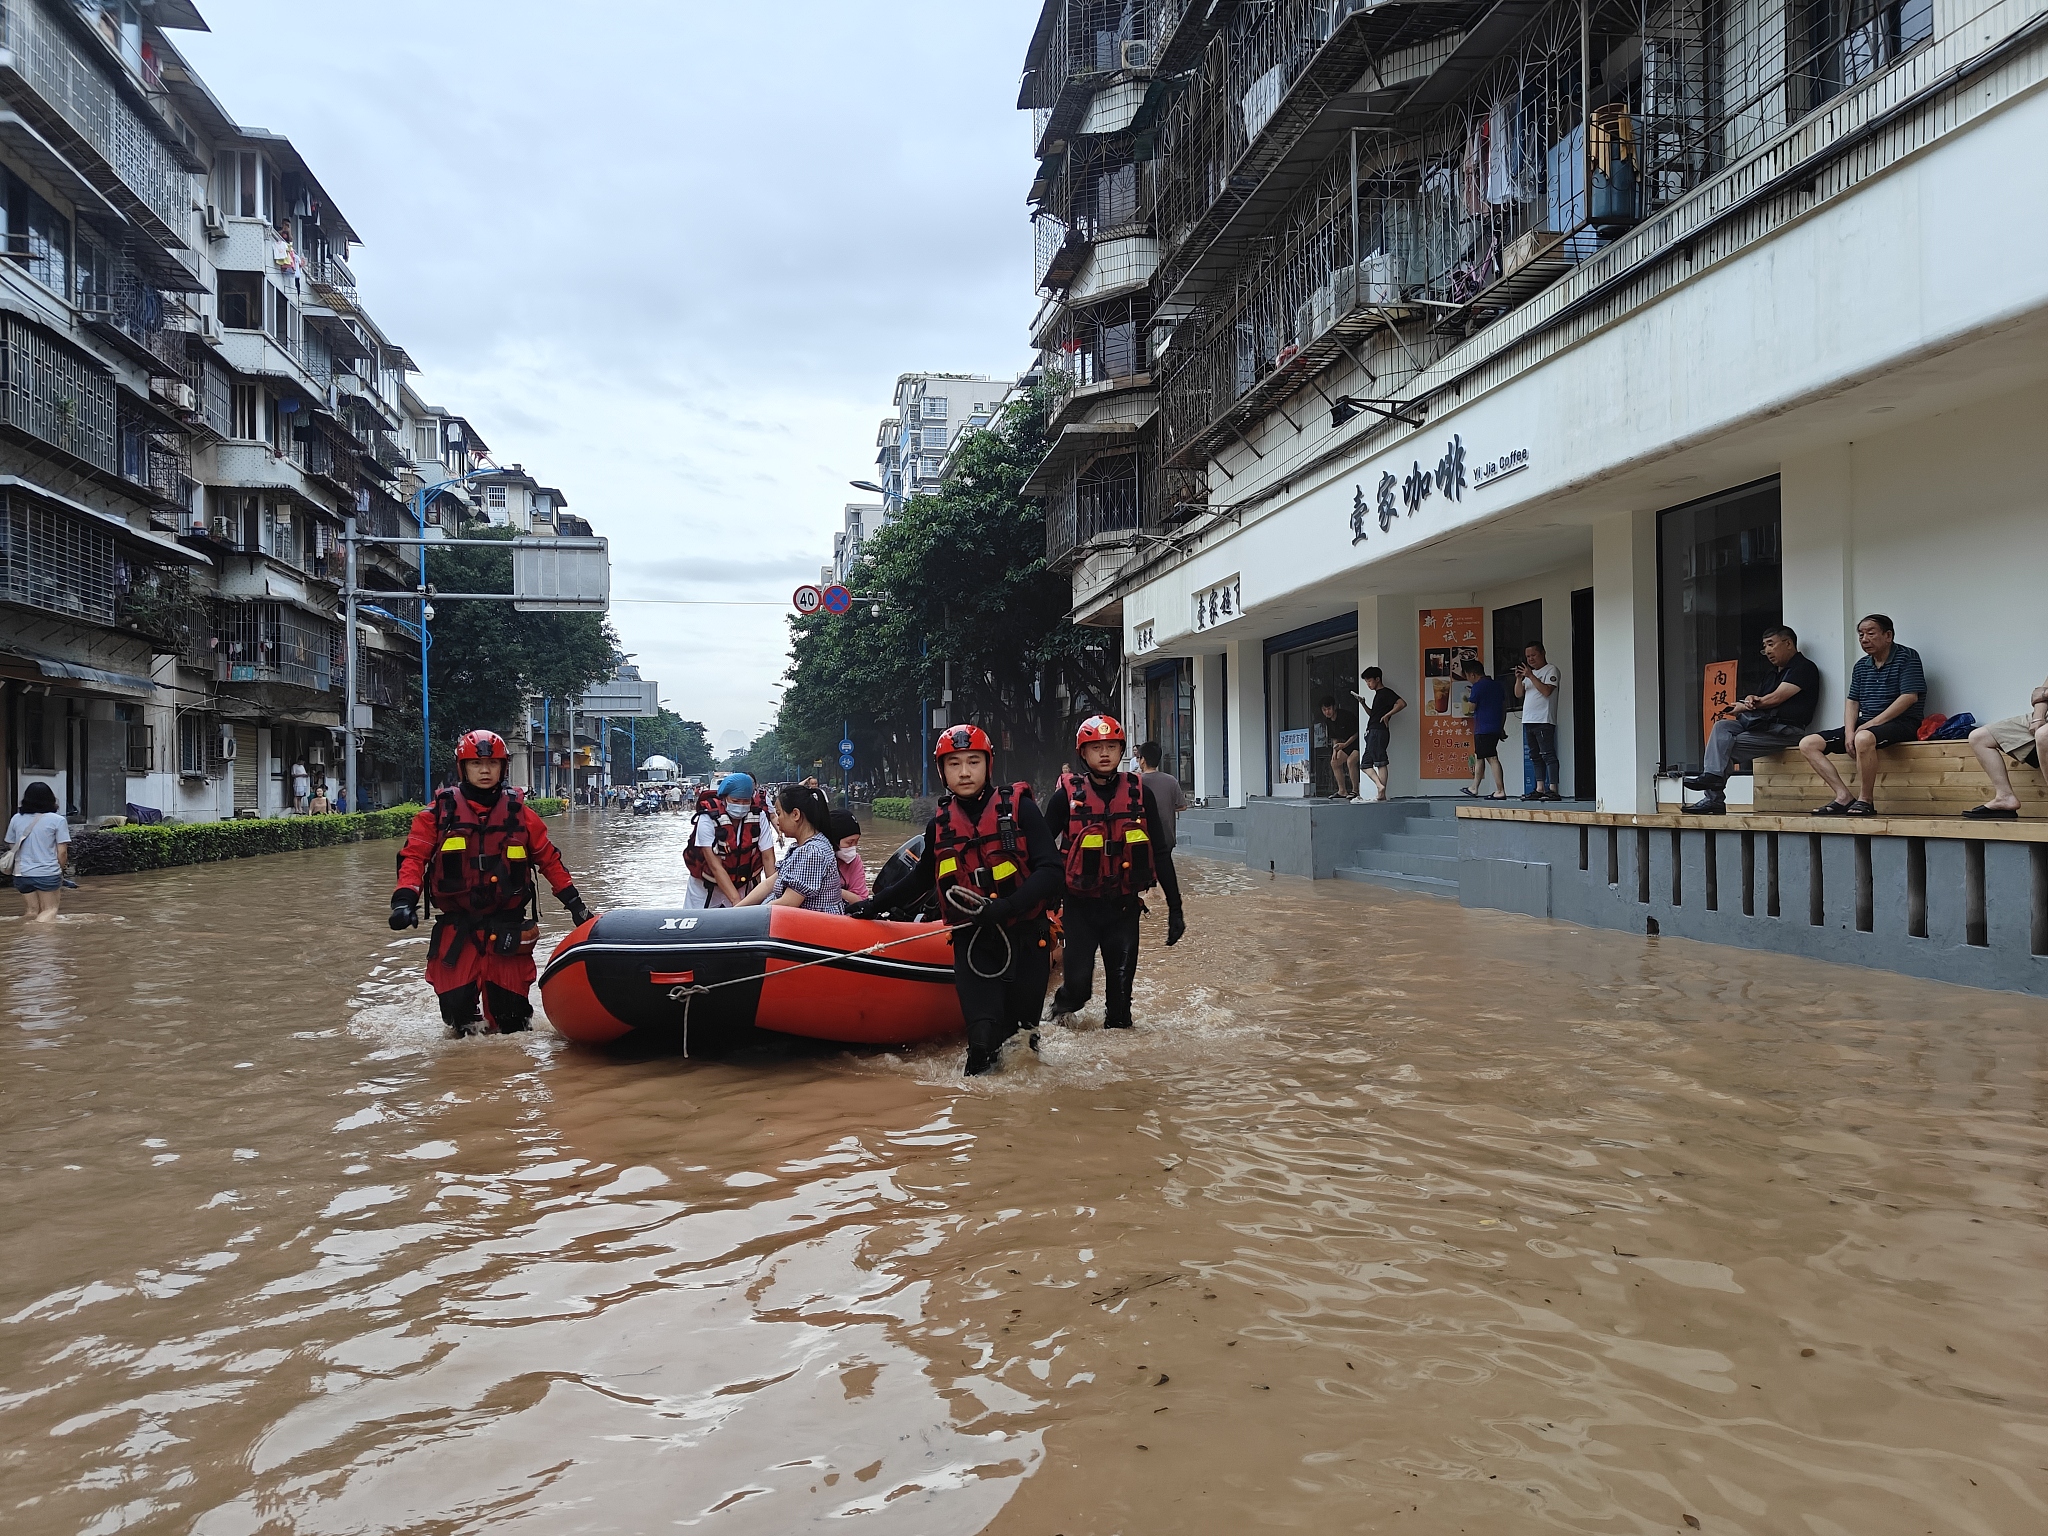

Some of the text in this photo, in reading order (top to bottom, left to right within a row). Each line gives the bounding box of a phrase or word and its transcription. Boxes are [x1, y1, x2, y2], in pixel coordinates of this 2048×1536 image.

[1472, 448, 1528, 481] Yi Jia Coffee
[1350, 433, 1467, 547] 壹家咖啡
[800, 592, 815, 607] 40
[1422, 612, 1454, 629] 新店
[1442, 629, 1477, 643] 试业
[658, 917, 699, 930] XG
